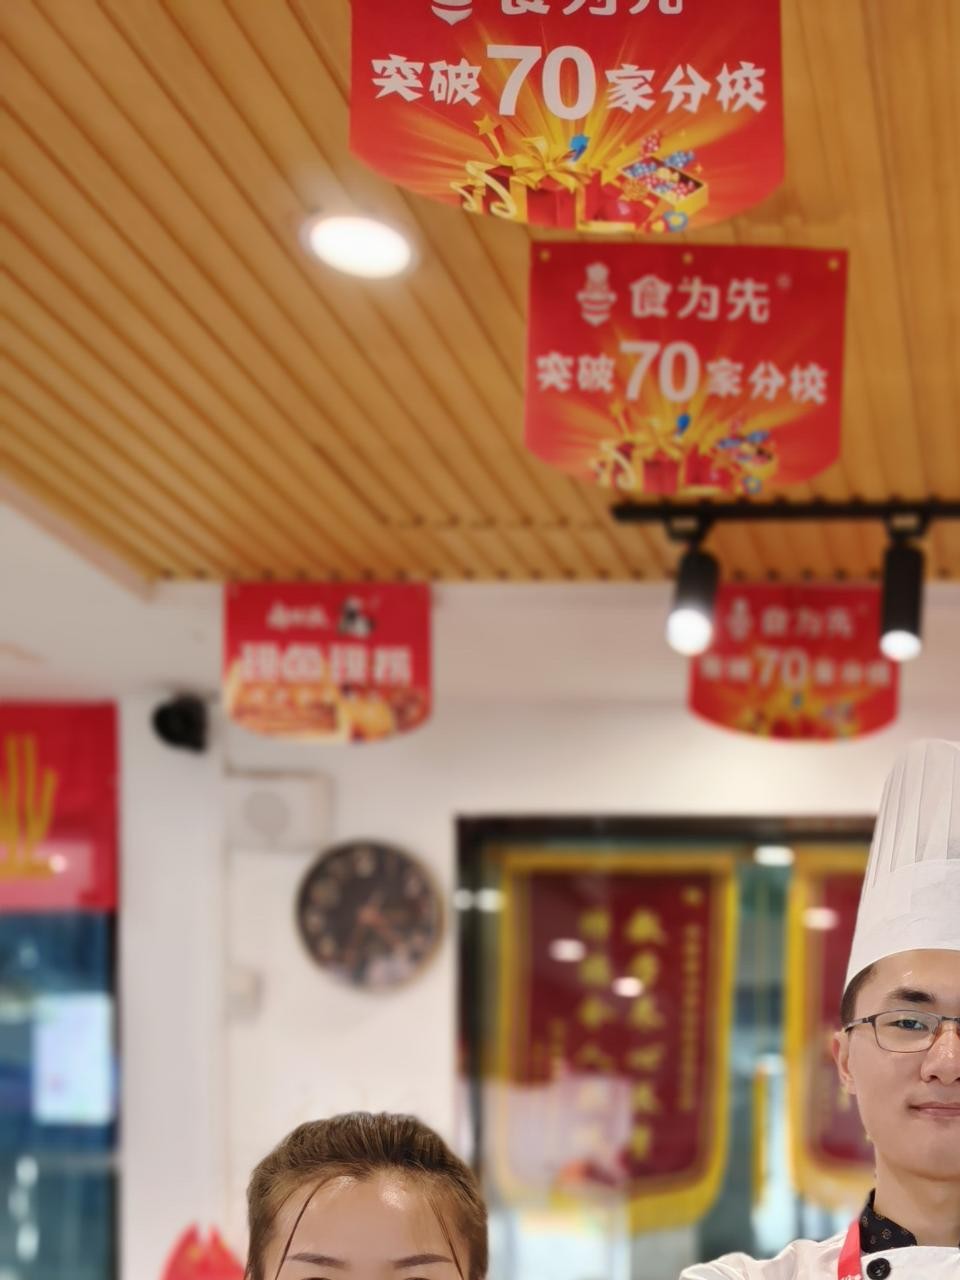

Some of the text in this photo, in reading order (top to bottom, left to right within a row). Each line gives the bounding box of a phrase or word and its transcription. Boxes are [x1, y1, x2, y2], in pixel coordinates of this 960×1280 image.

[371, 44, 767, 120] 突破70家分校
[629, 274, 770, 324] 食为先
[535, 341, 828, 404] 突破70家分校
